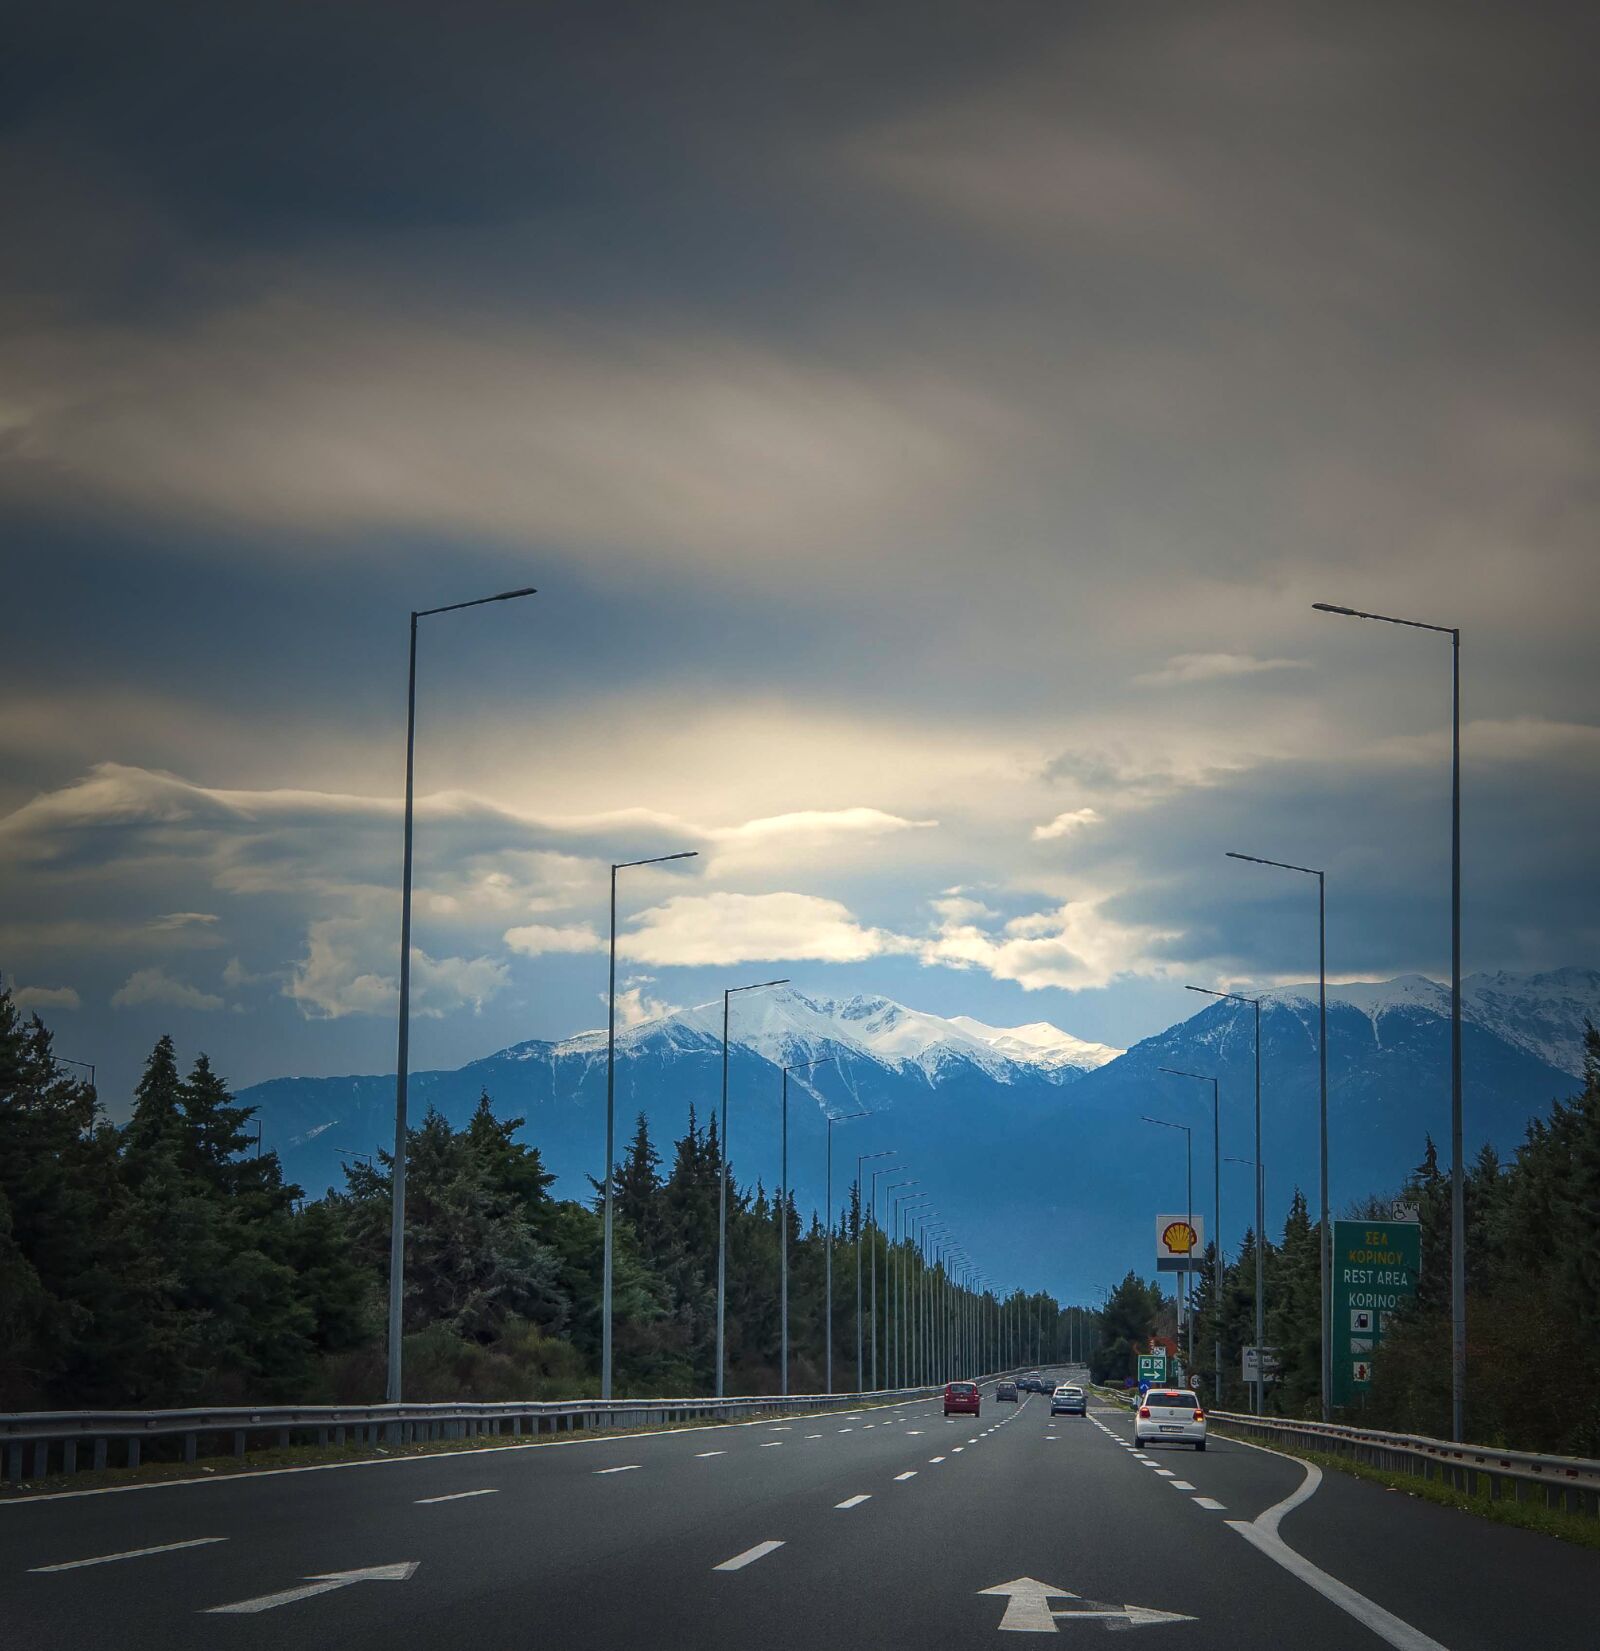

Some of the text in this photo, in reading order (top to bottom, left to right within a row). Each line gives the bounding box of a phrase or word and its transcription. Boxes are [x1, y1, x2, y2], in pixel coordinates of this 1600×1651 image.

[1404, 1202, 1418, 1211] WC
[1344, 1269, 1408, 1285] REST AREA
